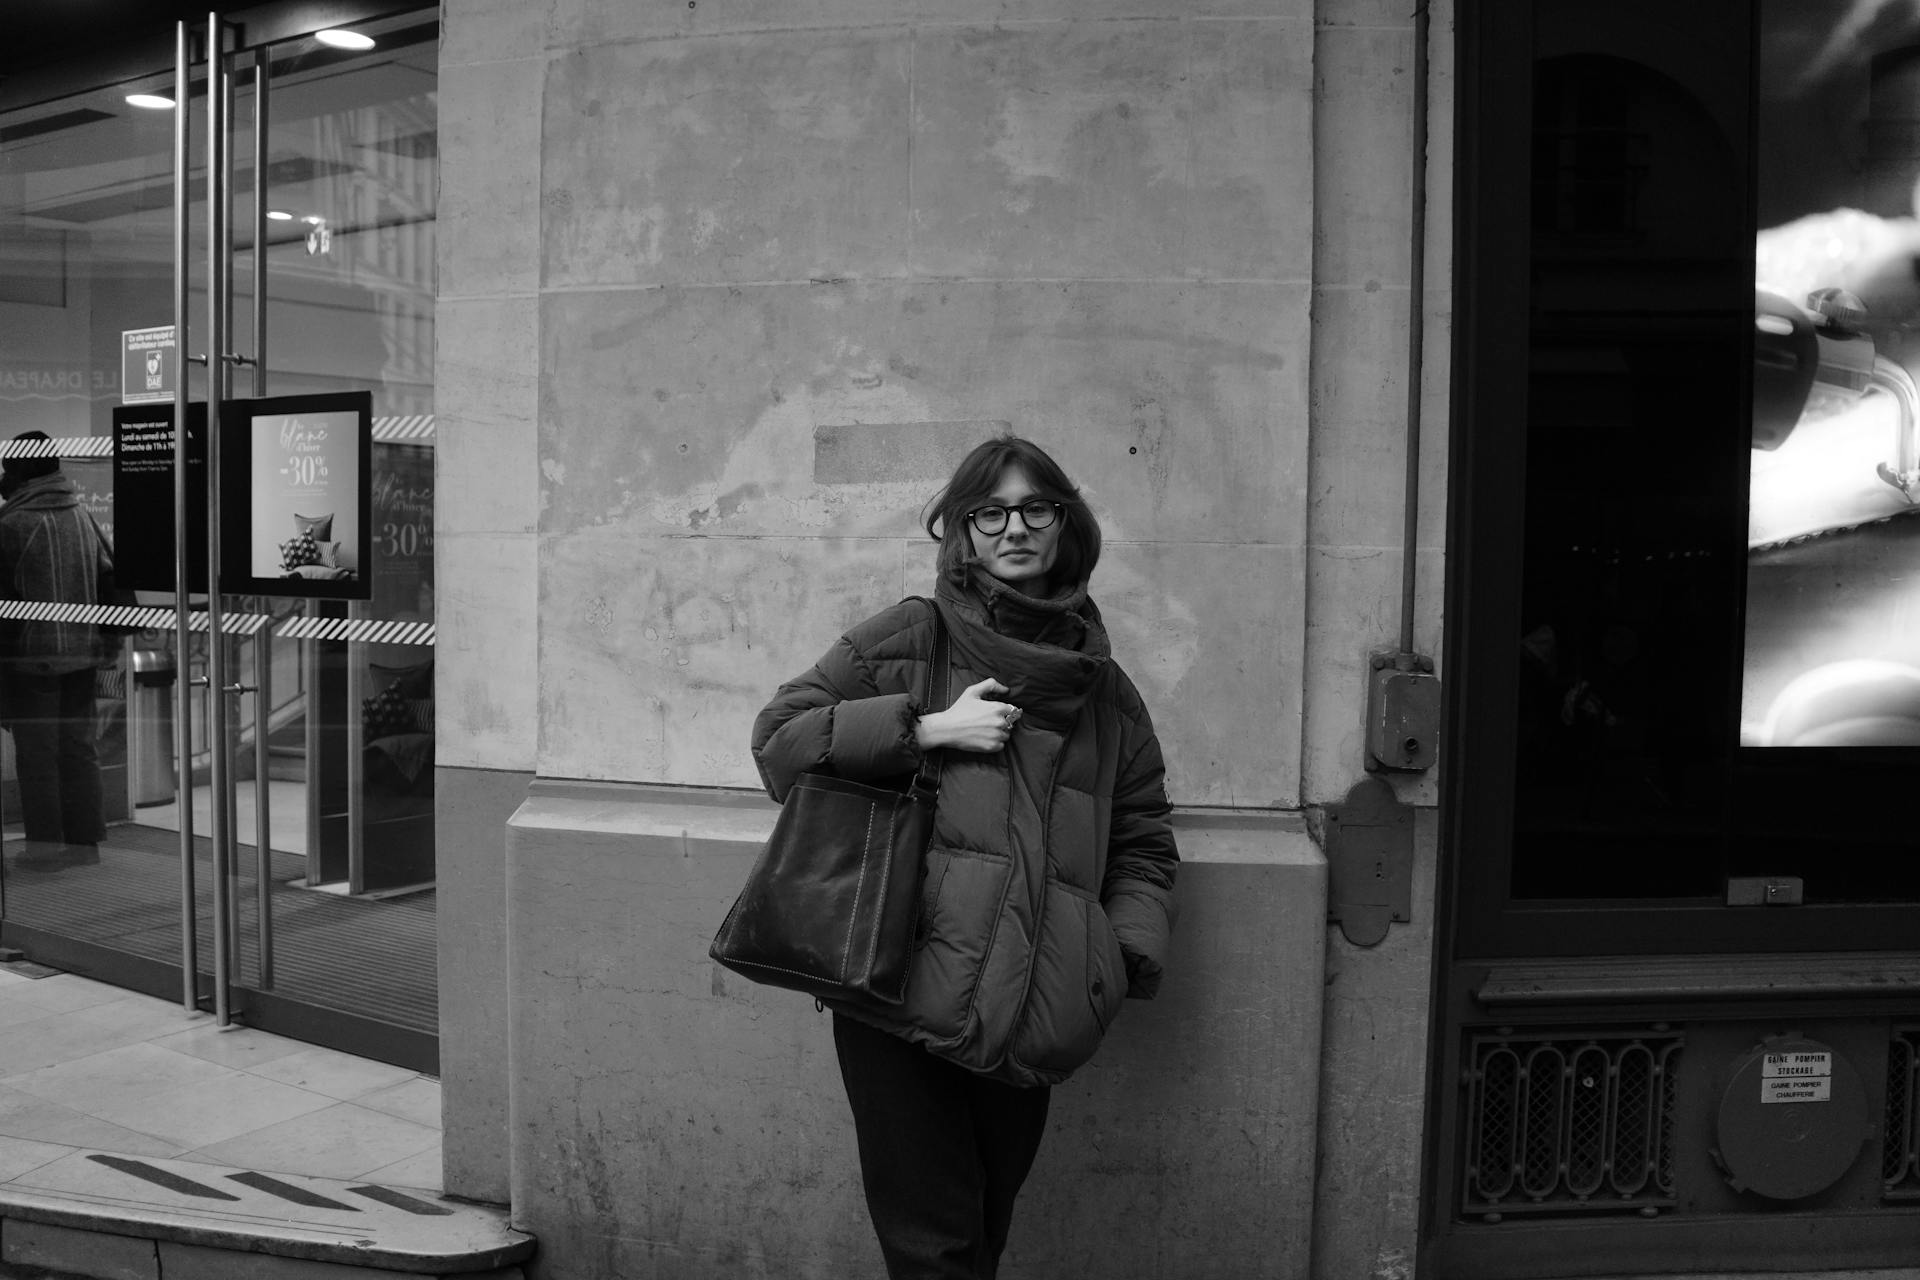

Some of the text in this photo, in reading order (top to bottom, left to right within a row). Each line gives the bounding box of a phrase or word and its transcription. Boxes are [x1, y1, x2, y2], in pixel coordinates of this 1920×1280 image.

[147, 376, 161, 386] DAE
[122, 432, 134, 441] Lundi
[142, 432, 159, 440] samedi
[122, 443, 144, 452] Dimanche
[146, 442, 152, 450] de
[280, 456, 328, 486] -30%
[1768, 1056, 1788, 1064] GAINE
